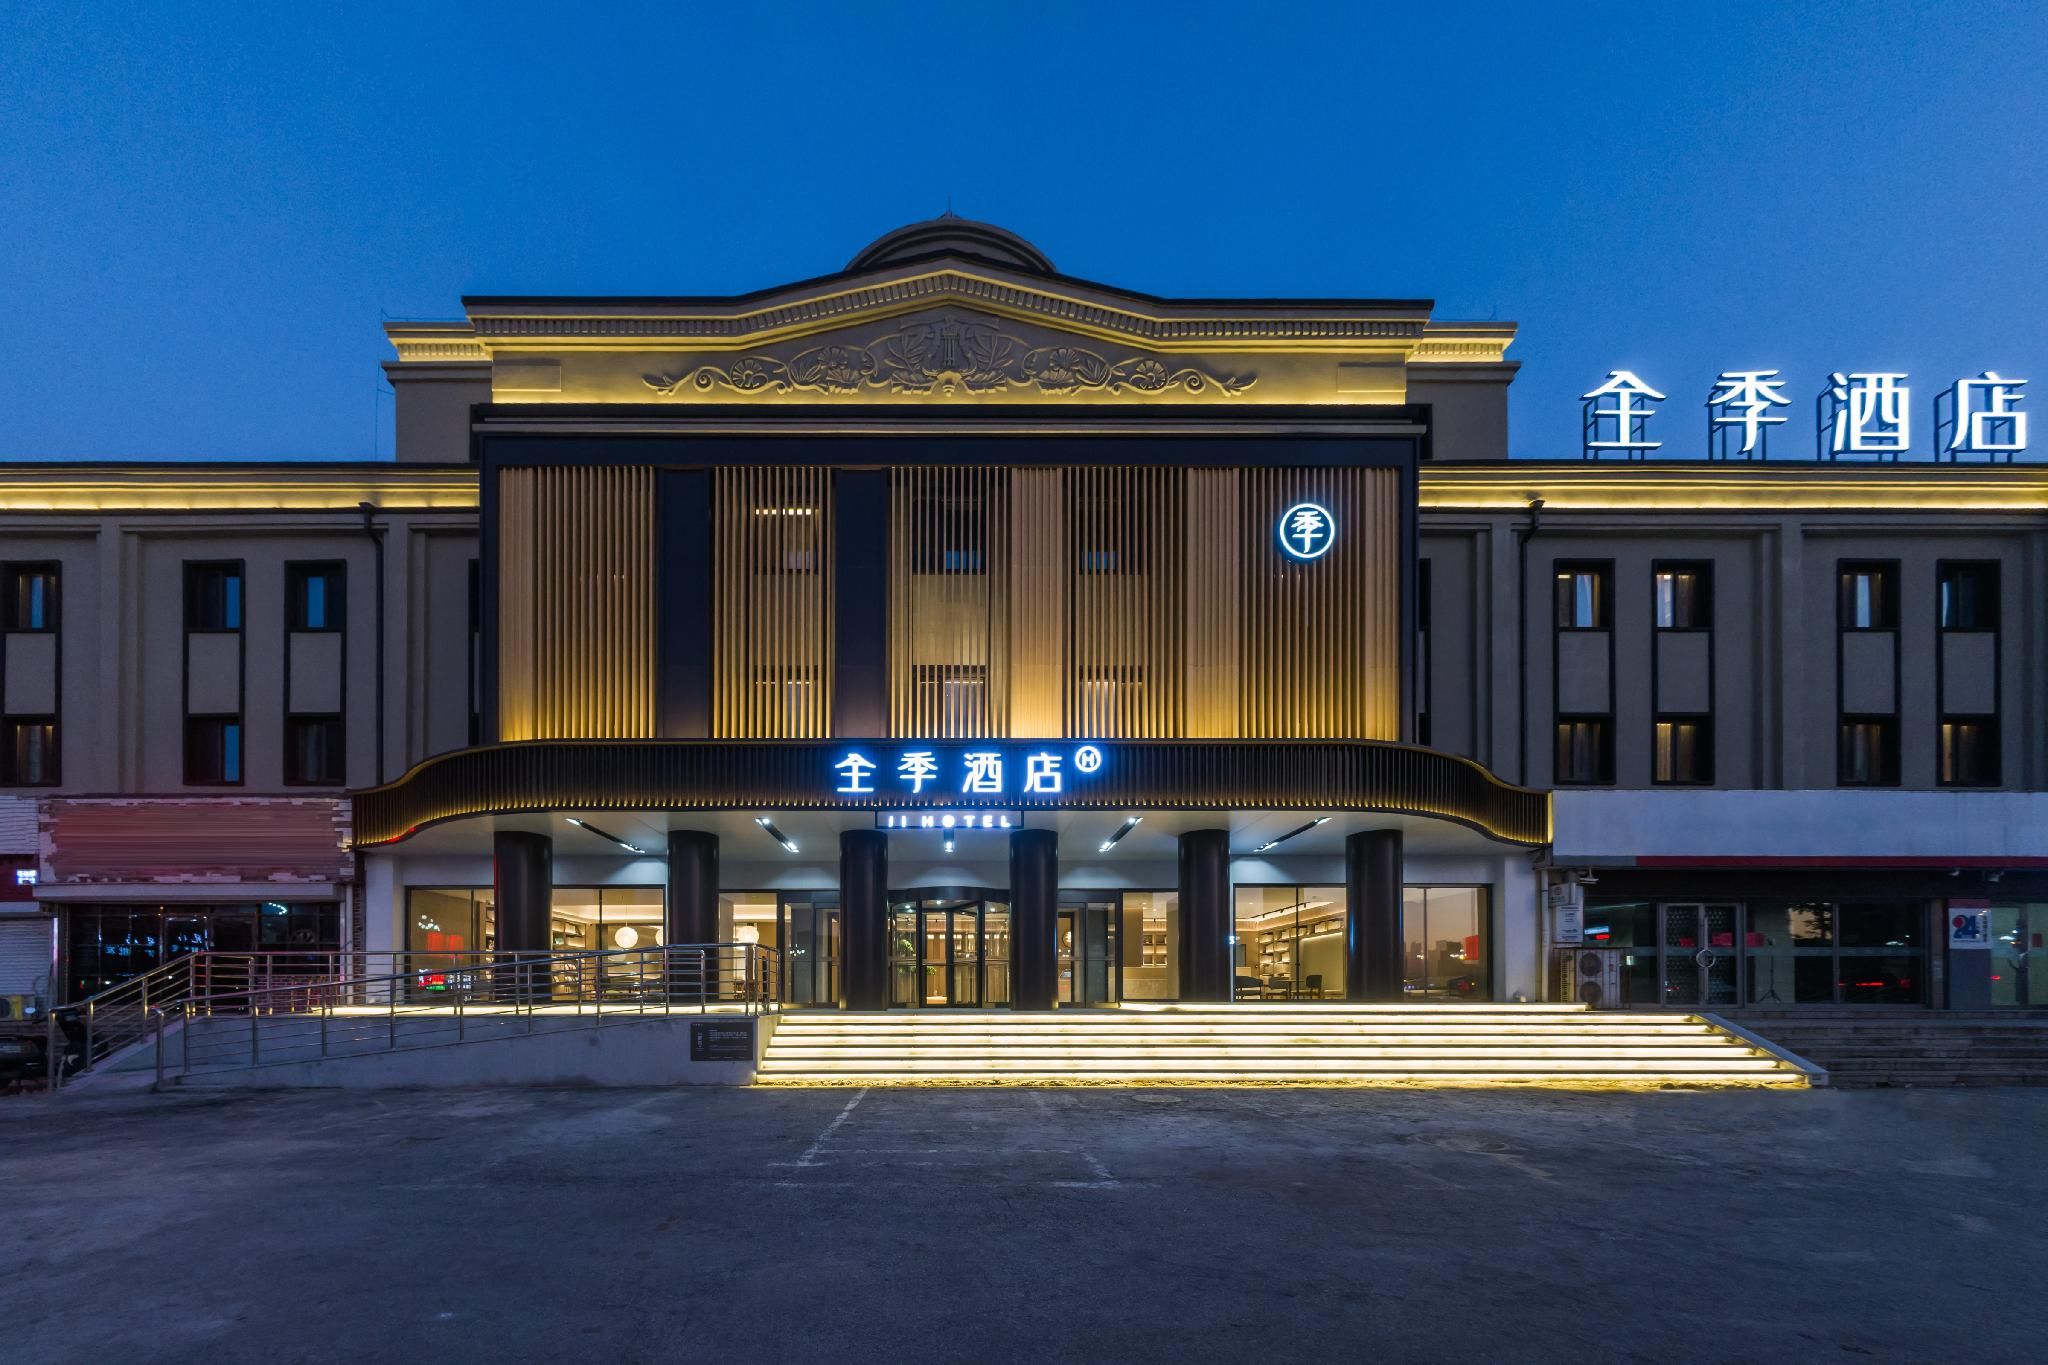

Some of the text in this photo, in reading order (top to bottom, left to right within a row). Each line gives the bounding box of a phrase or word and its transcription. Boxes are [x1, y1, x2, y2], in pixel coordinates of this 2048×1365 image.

[1582, 369, 2029, 454] 全季酒店
[1291, 510, 1324, 553] 季
[834, 751, 1063, 793] 全季酒店
[921, 815, 1011, 828] HOTEL
